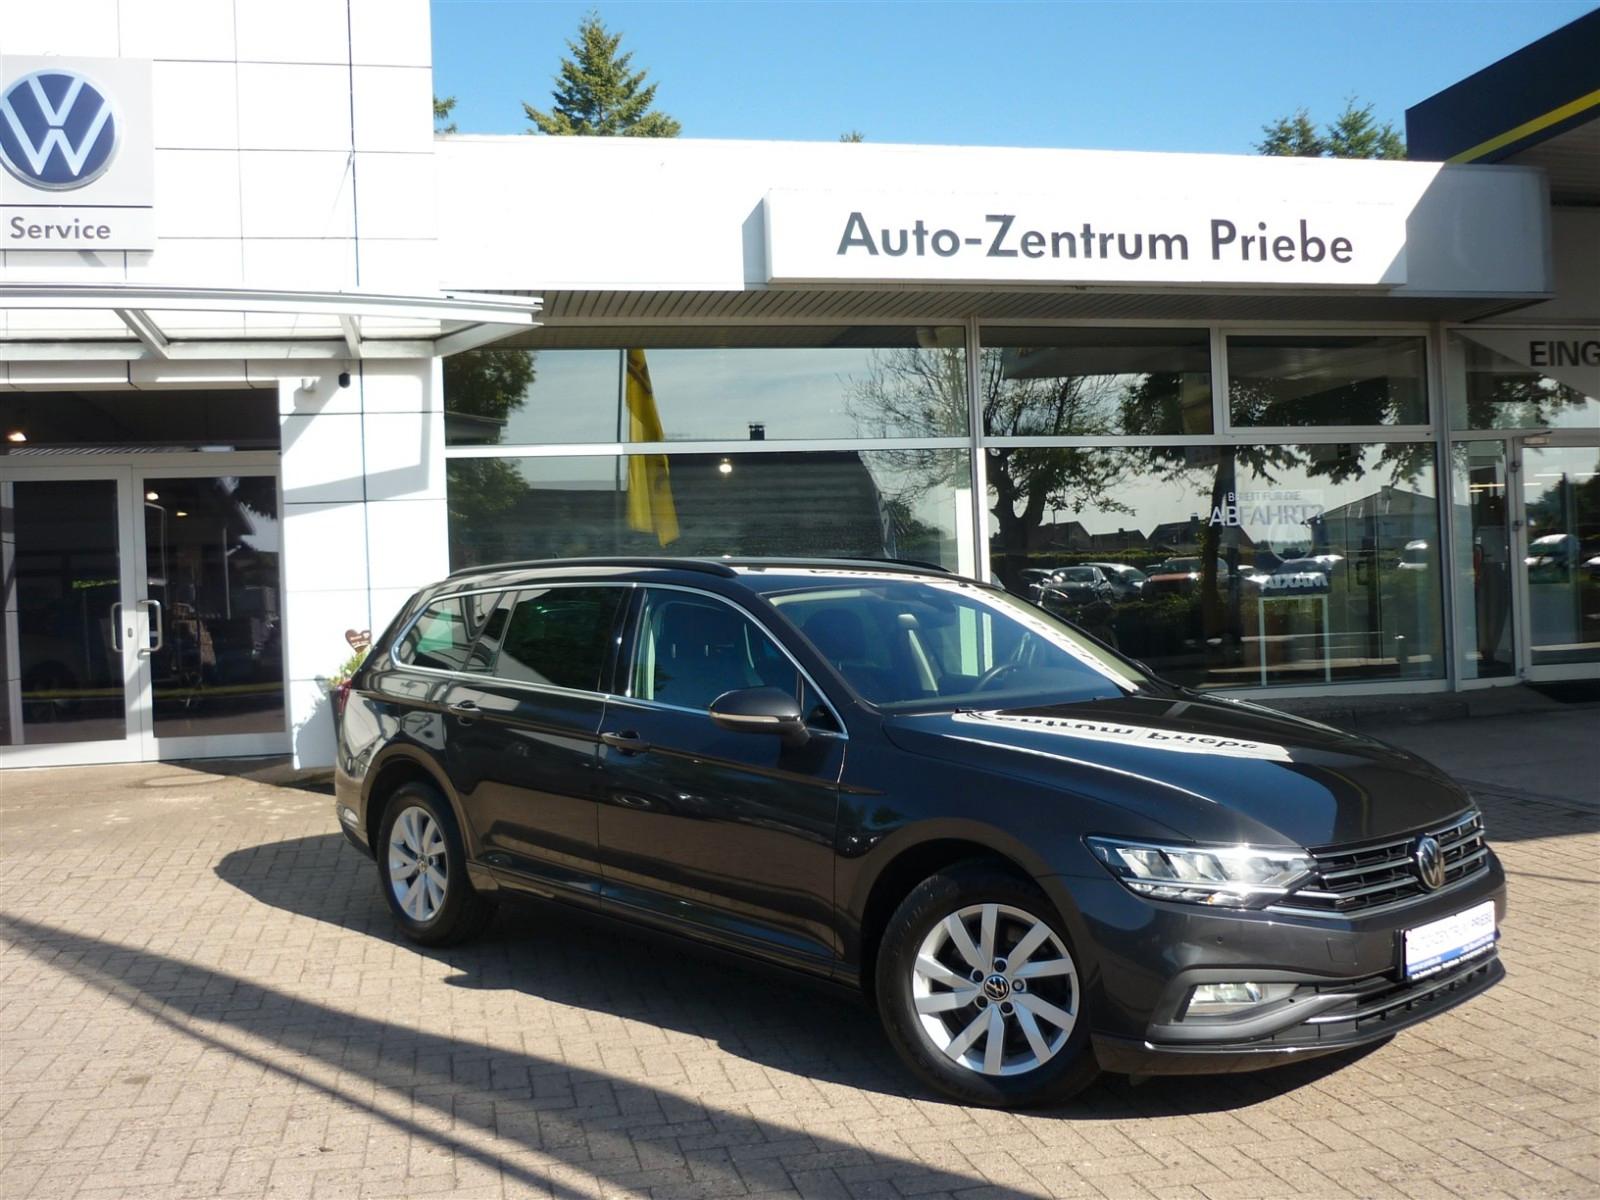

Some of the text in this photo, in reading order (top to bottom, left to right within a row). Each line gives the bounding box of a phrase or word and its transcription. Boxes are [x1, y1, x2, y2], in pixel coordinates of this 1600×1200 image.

[10, 216, 111, 240] Service
[836, 211, 1354, 264] Auto-Zentrum Priebe
[1529, 341, 1600, 367] EING
[1208, 503, 1325, 527] ABFAHRT?
